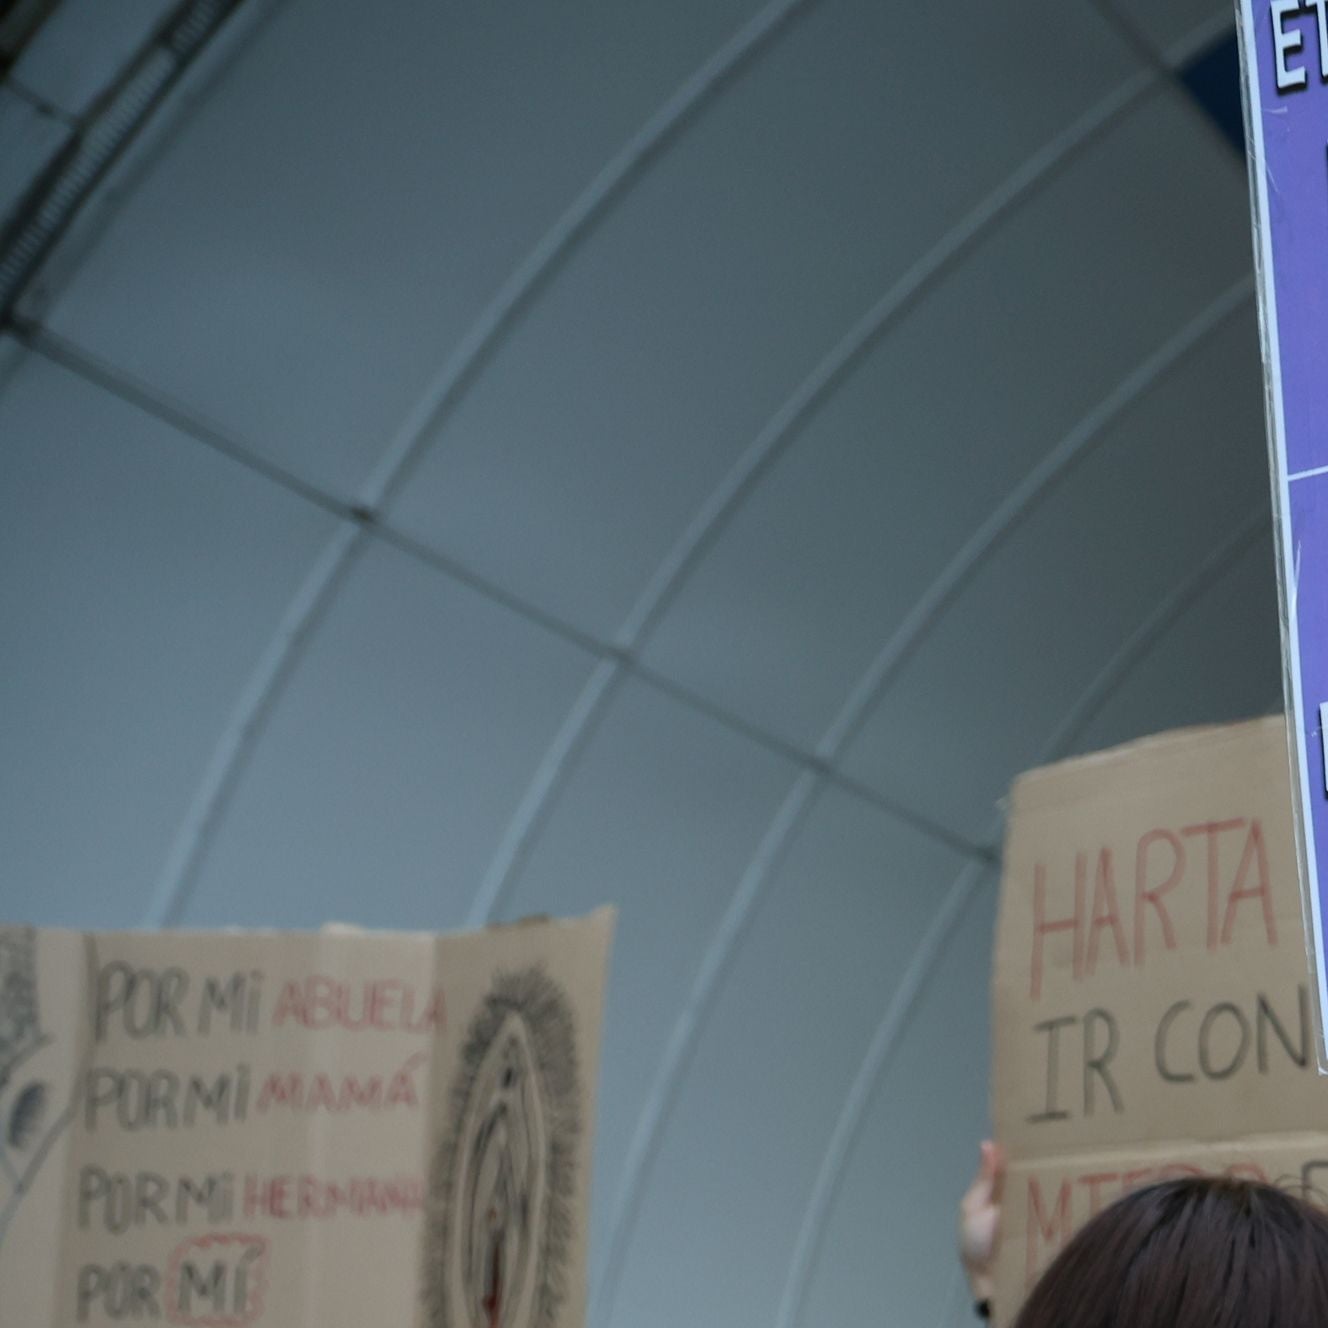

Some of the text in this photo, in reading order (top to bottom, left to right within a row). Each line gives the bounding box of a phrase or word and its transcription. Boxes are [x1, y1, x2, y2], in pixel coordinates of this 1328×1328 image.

[1029, 818, 1279, 1000] HARTA
[95, 960, 190, 1044] POR
[271, 972, 448, 1035] ABUELA
[84, 1064, 180, 1132] POR
[256, 1052, 427, 1116] MAMÁ
[1026, 985, 1307, 1125] IR CON
[78, 1163, 170, 1234] POR
[76, 1261, 163, 1324] POR
